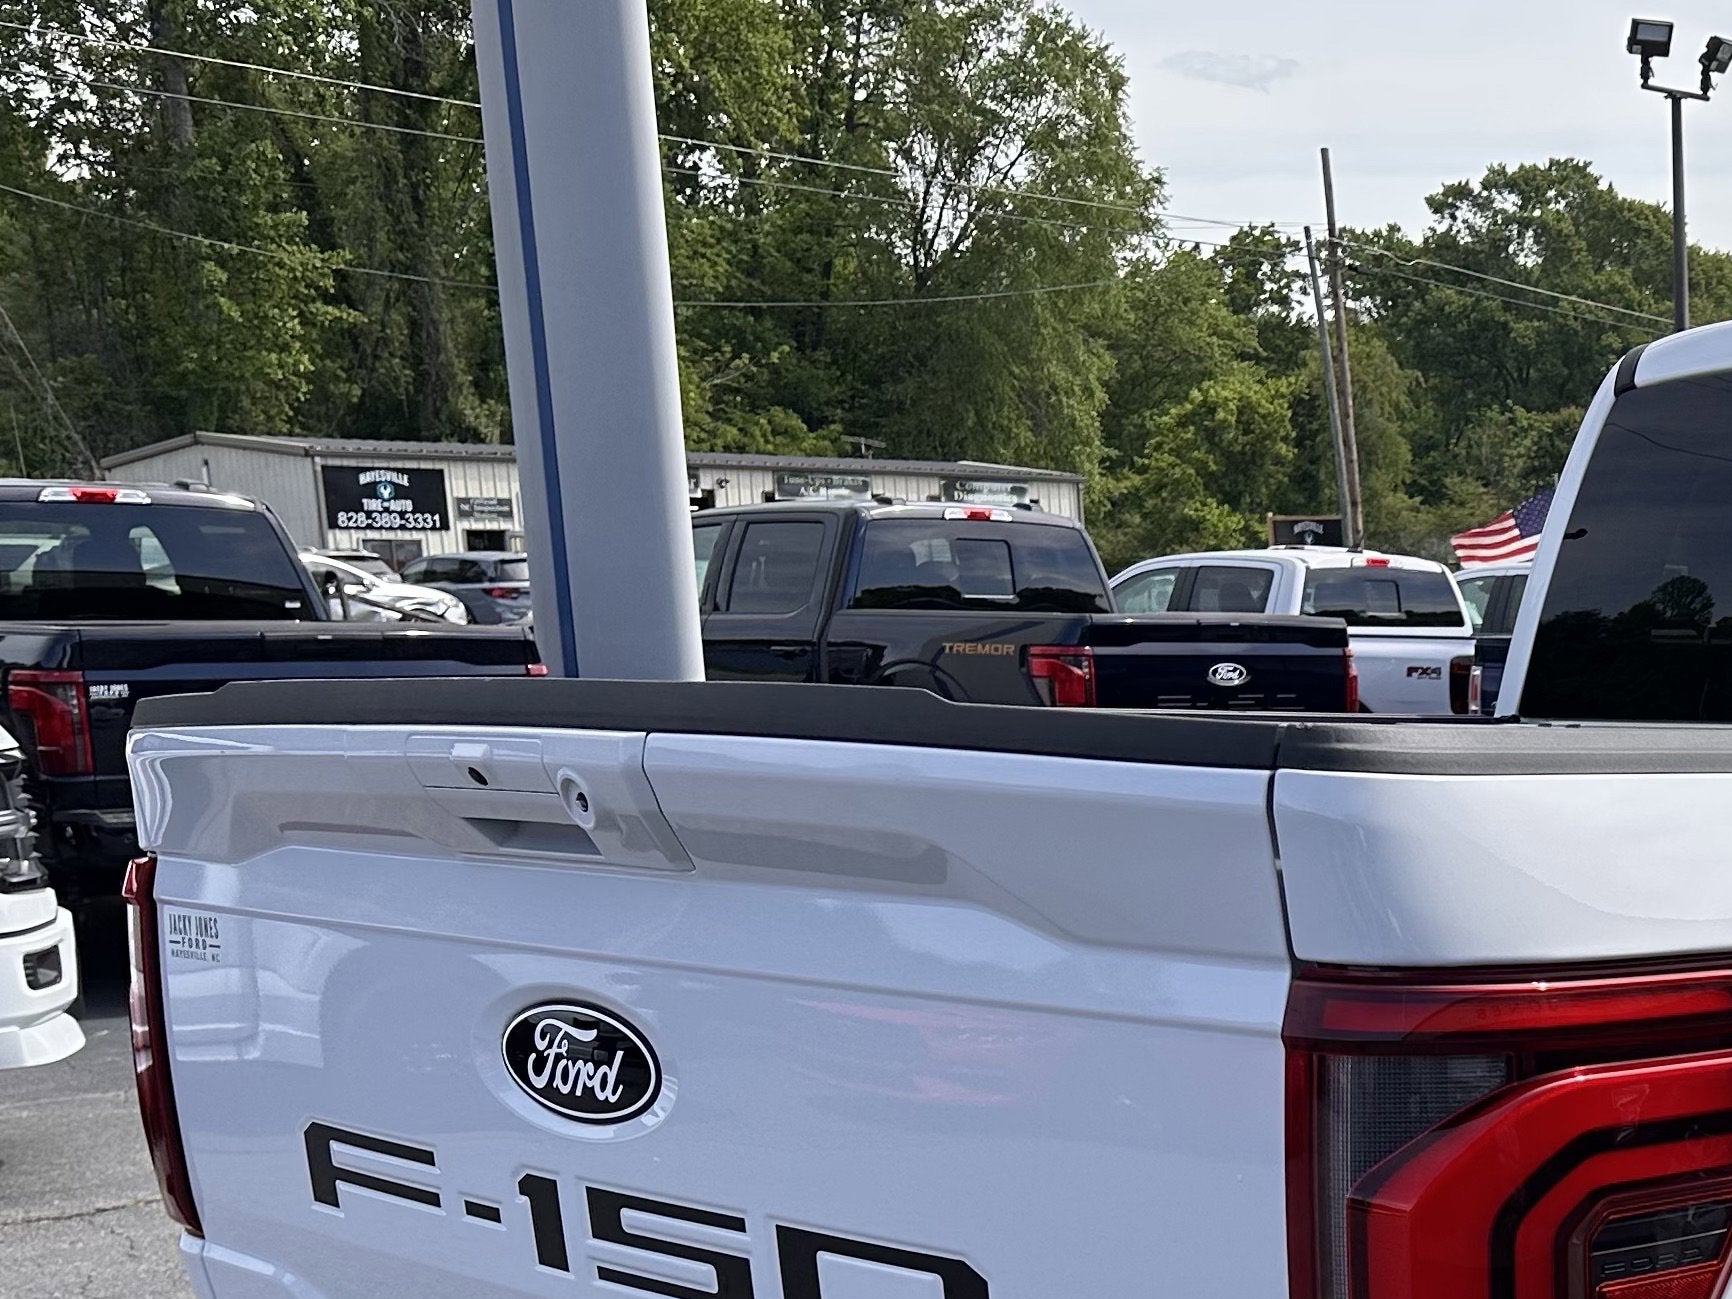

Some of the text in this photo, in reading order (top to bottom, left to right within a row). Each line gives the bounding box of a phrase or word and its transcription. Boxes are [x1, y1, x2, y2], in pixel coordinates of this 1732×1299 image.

[336, 511, 441, 529] 828-389-3331
[942, 642, 1016, 656] TREMOR
[1215, 665, 1241, 681] Ford
[181, 936, 207, 951] FORD
[527, 1018, 624, 1103] Ford
